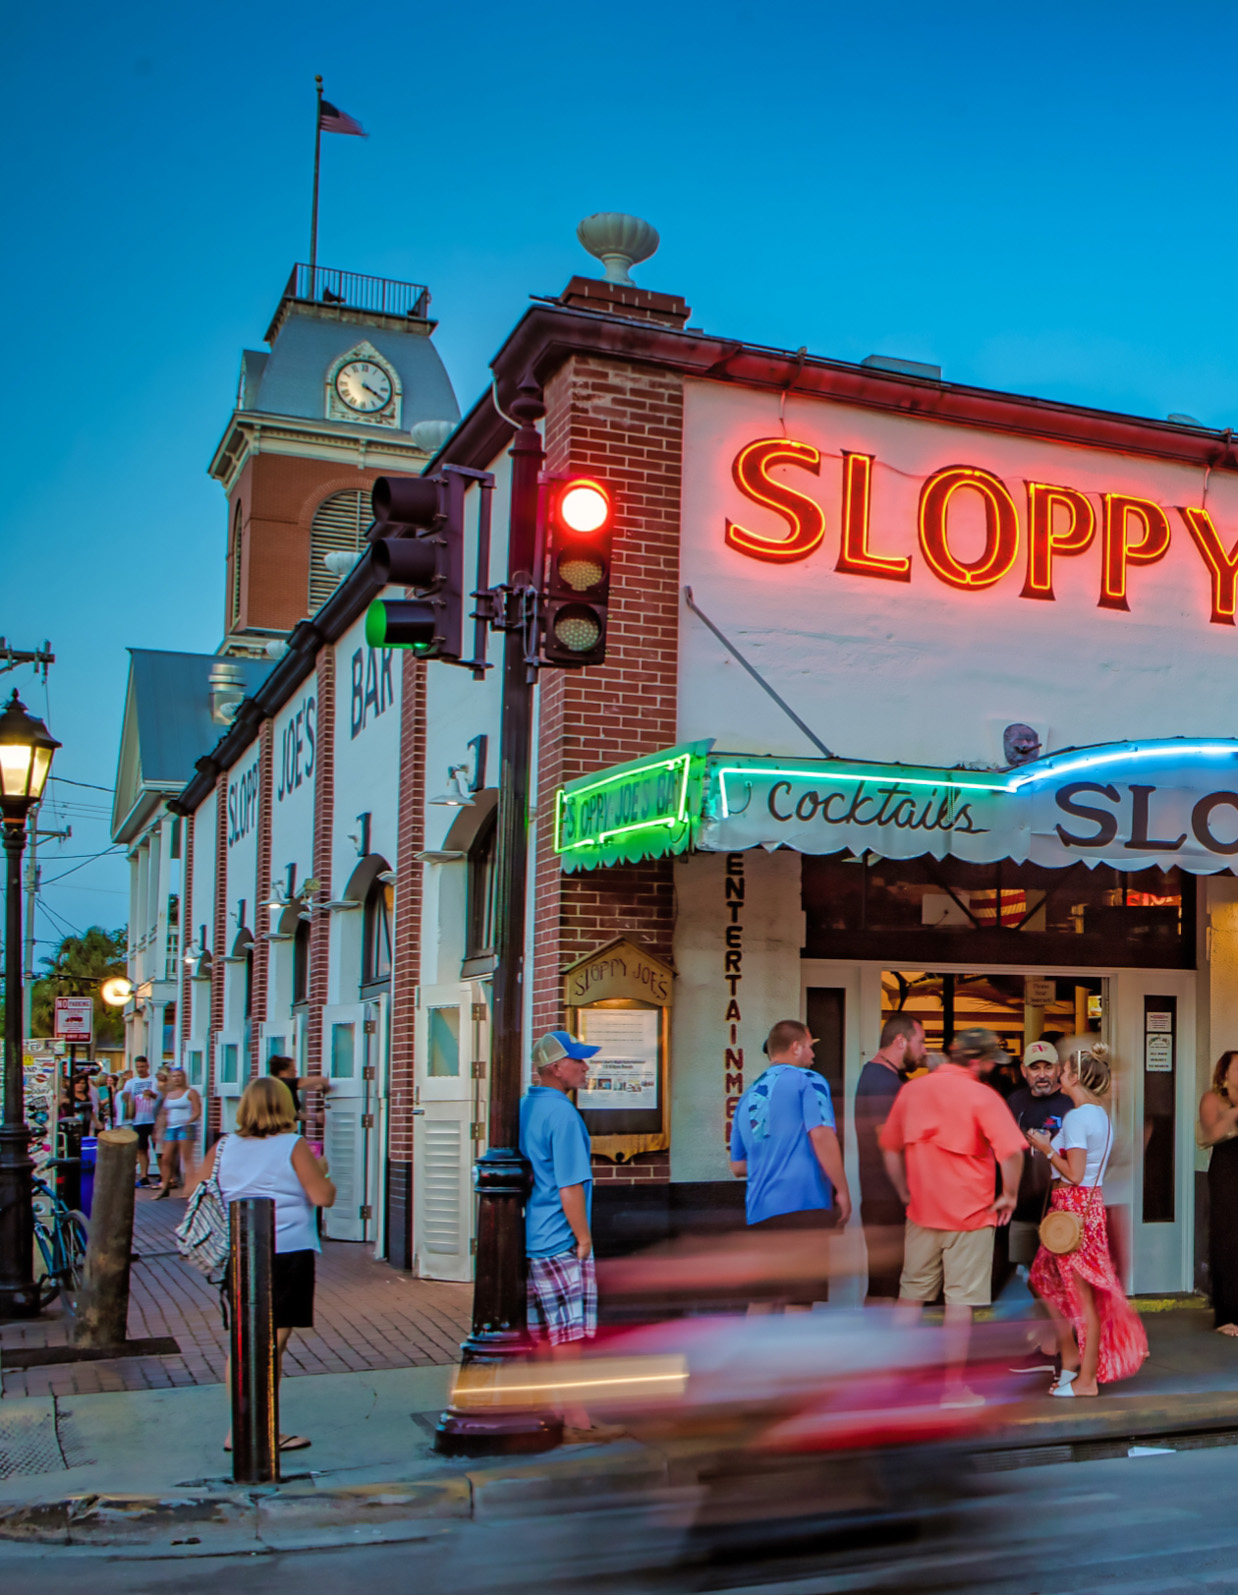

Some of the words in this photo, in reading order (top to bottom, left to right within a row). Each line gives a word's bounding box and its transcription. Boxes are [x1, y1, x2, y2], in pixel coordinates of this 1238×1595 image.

[351, 648, 393, 741] BAR
[278, 696, 316, 803] JOE'S
[656, 771, 683, 816] BA
[228, 756, 260, 848] SLOPP
[768, 780, 991, 834] Cocktails
[574, 958, 627, 997] SLOPPY
[632, 962, 668, 1001] JOE'S
[724, 852, 745, 1152] ENTERTAINME
